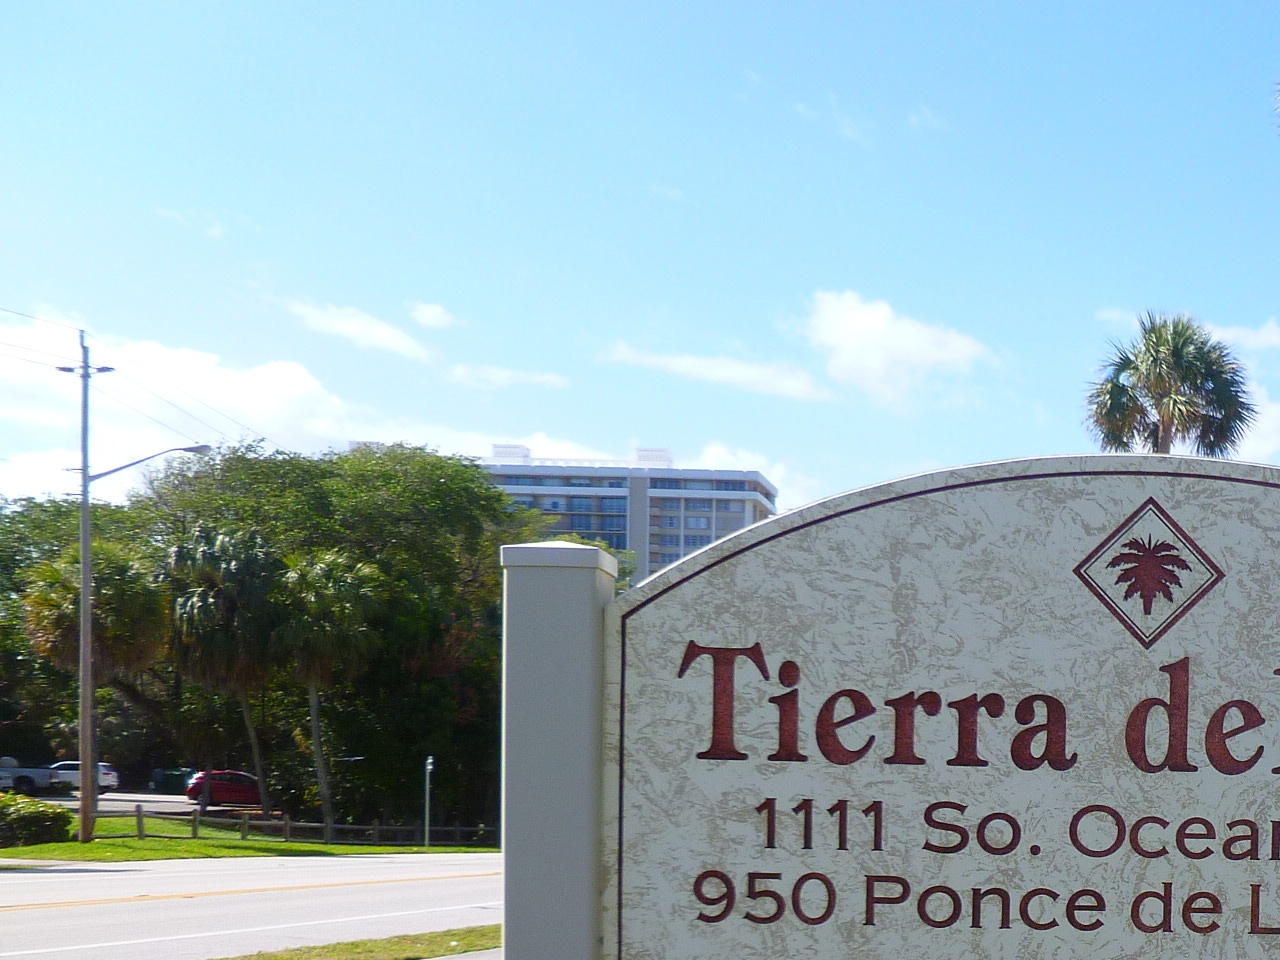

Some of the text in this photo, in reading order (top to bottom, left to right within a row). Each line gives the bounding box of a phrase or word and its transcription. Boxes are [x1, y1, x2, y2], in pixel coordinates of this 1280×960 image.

[677, 638, 1079, 772] Tierra
[755, 797, 885, 852] 1111
[922, 800, 1042, 860] So.
[692, 869, 838, 925] 950
[863, 874, 1106, 932] Ponce
[1131, 881, 1224, 936] de
